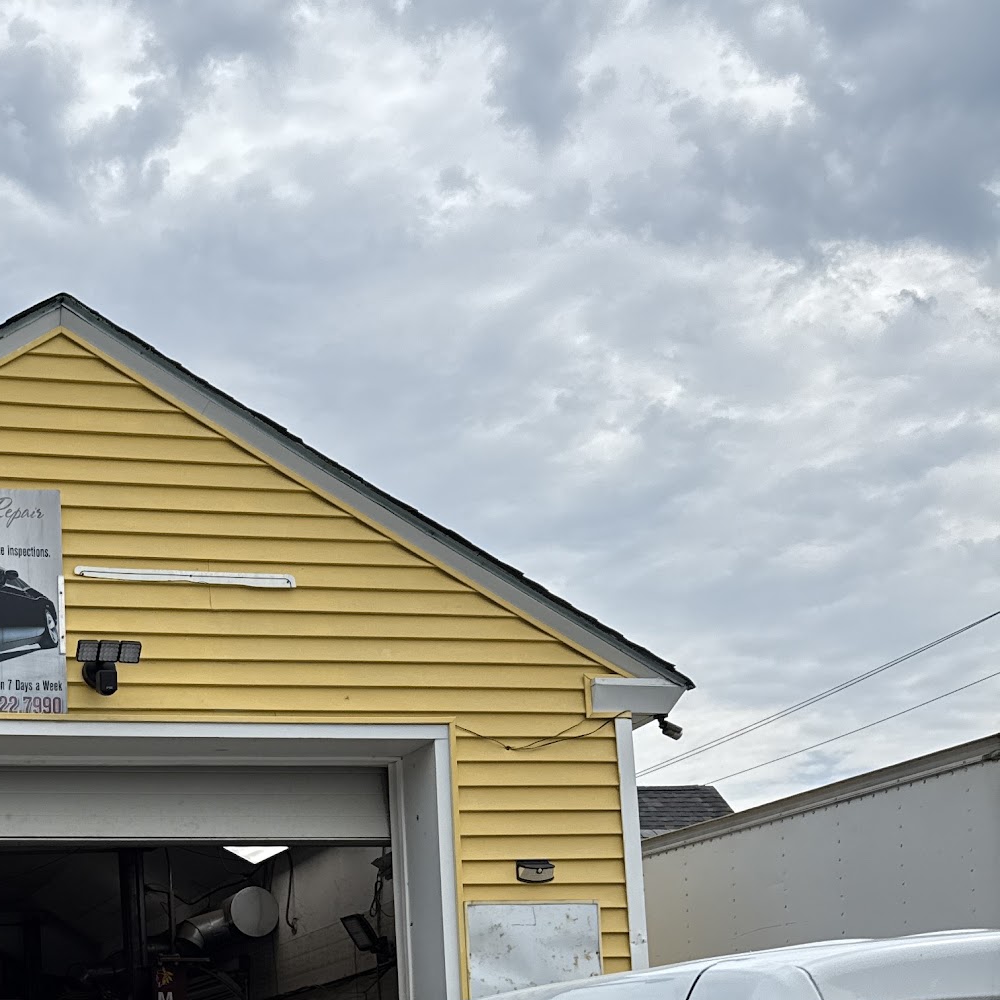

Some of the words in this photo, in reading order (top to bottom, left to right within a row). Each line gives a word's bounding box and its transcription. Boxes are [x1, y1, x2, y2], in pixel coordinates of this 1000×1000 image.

[8, 679, 12, 690] 7
[15, 680, 33, 692] Days
[35, 683, 40, 691] a
[42, 680, 63, 691] Week
